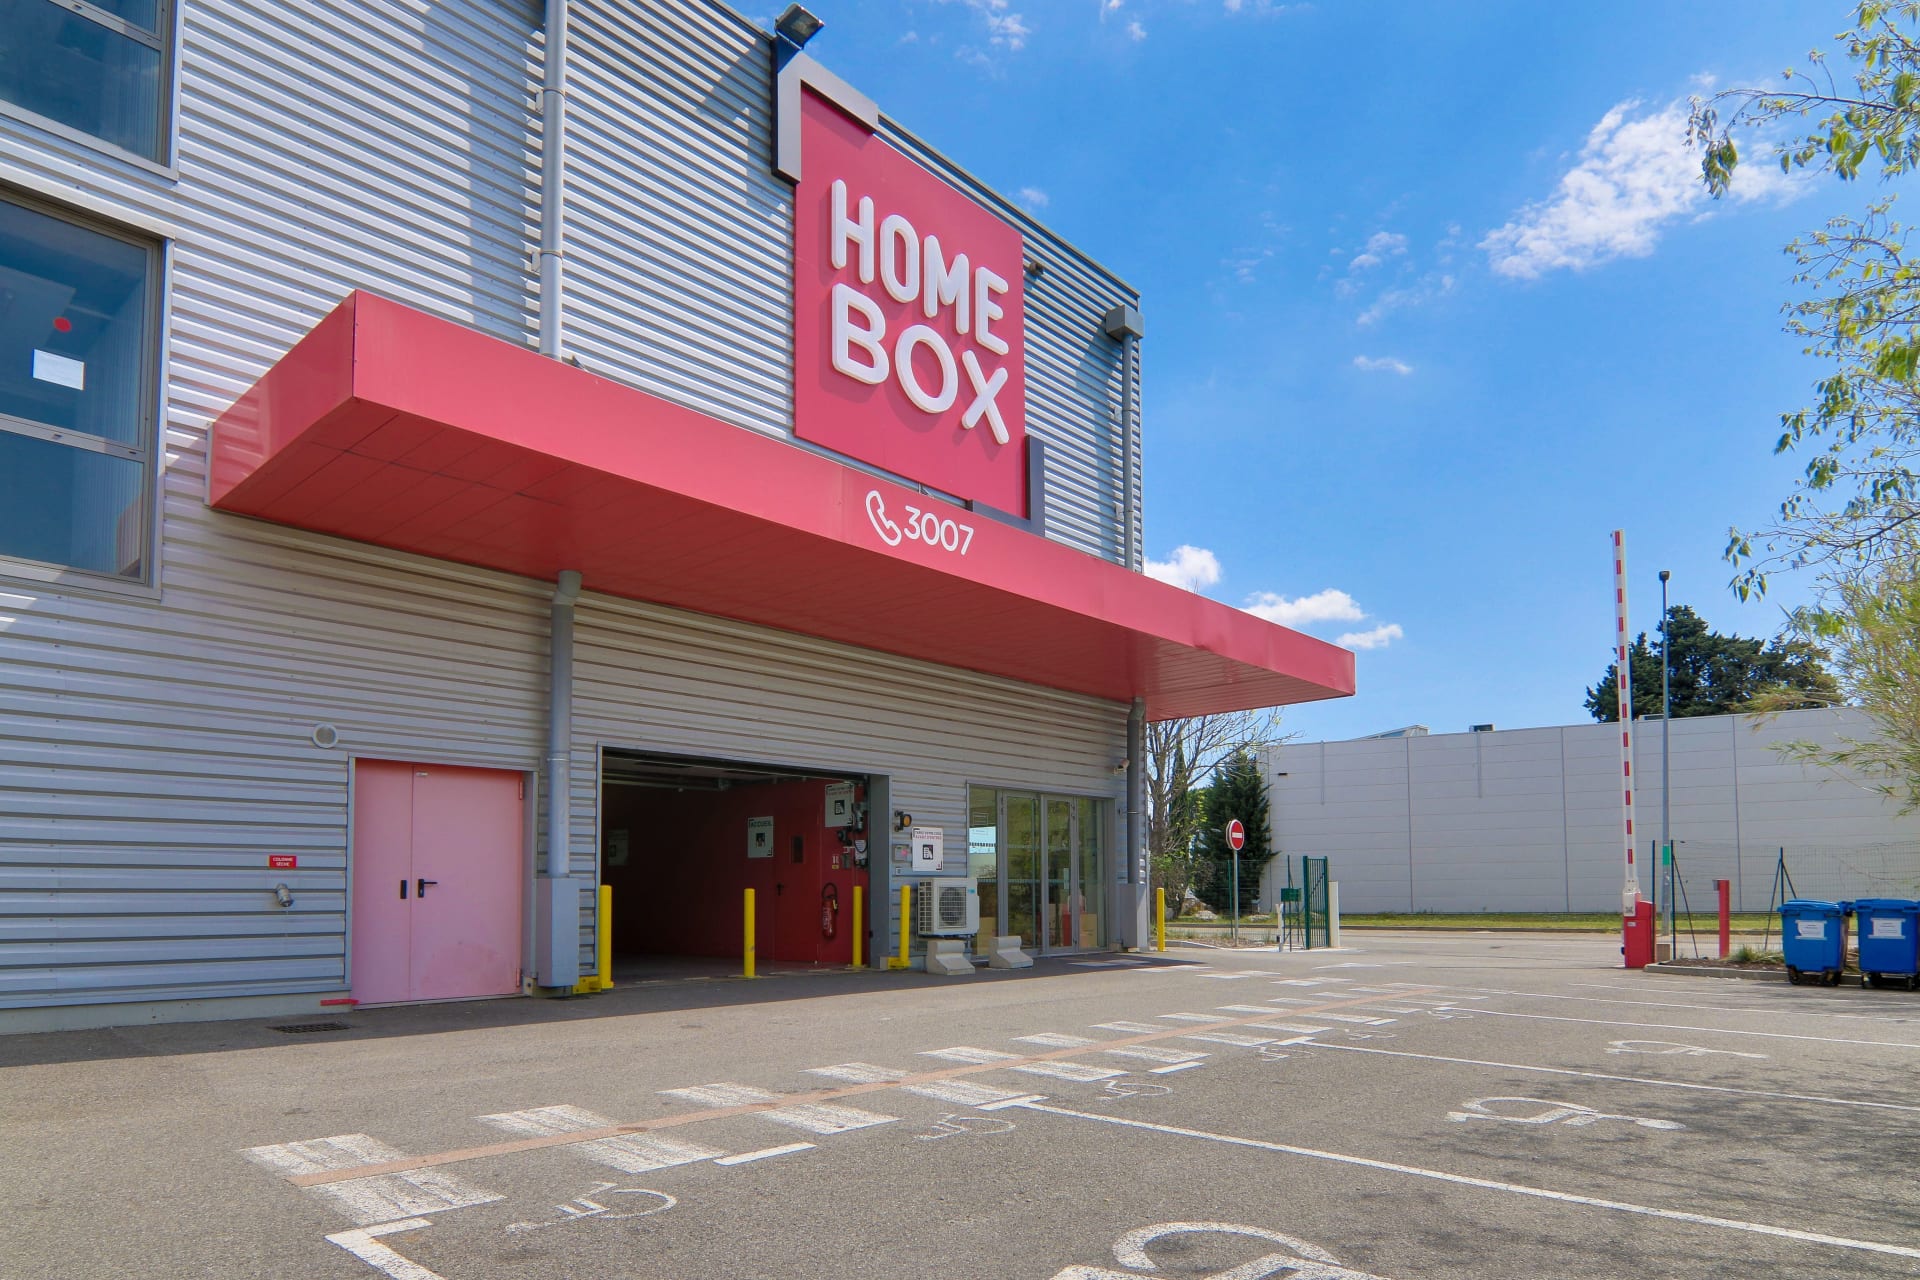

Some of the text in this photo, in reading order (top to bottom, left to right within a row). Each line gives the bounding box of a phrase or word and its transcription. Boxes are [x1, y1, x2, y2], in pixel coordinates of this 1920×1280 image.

[831, 179, 1009, 355] HOME
[831, 283, 1009, 444] BOX
[903, 505, 974, 555] 3007
